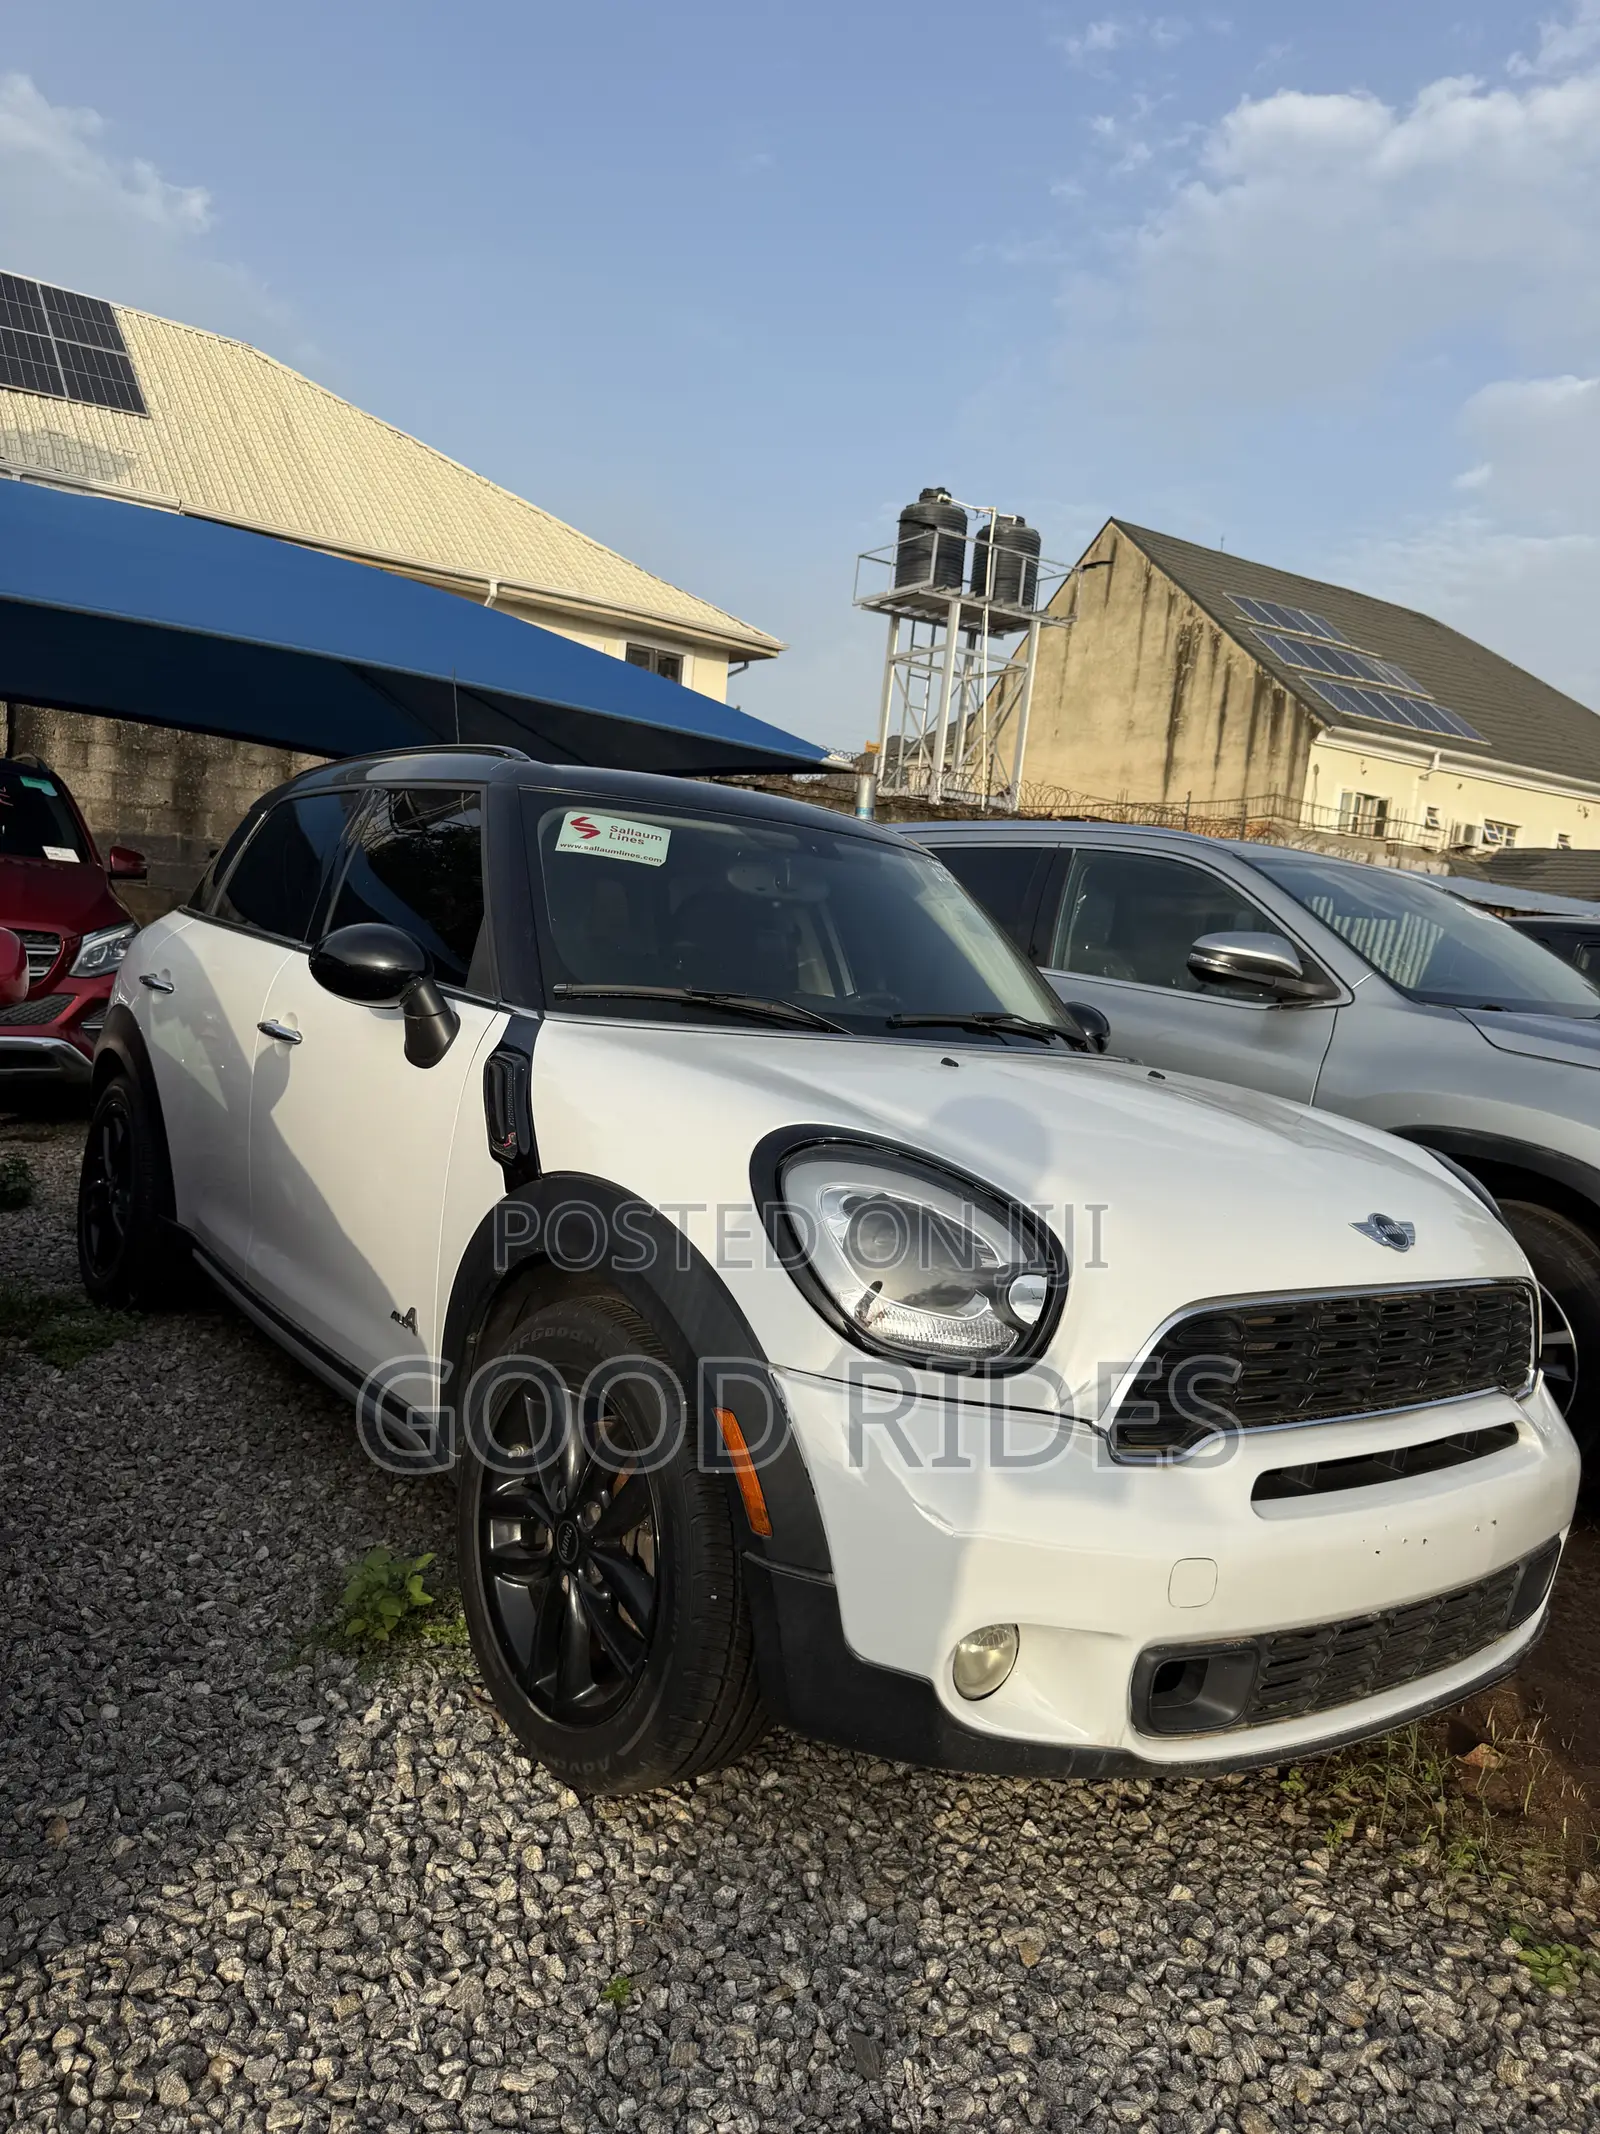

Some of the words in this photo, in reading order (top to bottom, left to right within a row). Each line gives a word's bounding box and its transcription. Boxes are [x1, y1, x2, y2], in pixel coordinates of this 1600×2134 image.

[609, 832, 645, 845] Lines
[610, 825, 662, 842] Sallaum
[560, 843, 662, 863] www.sallaumlines.com
